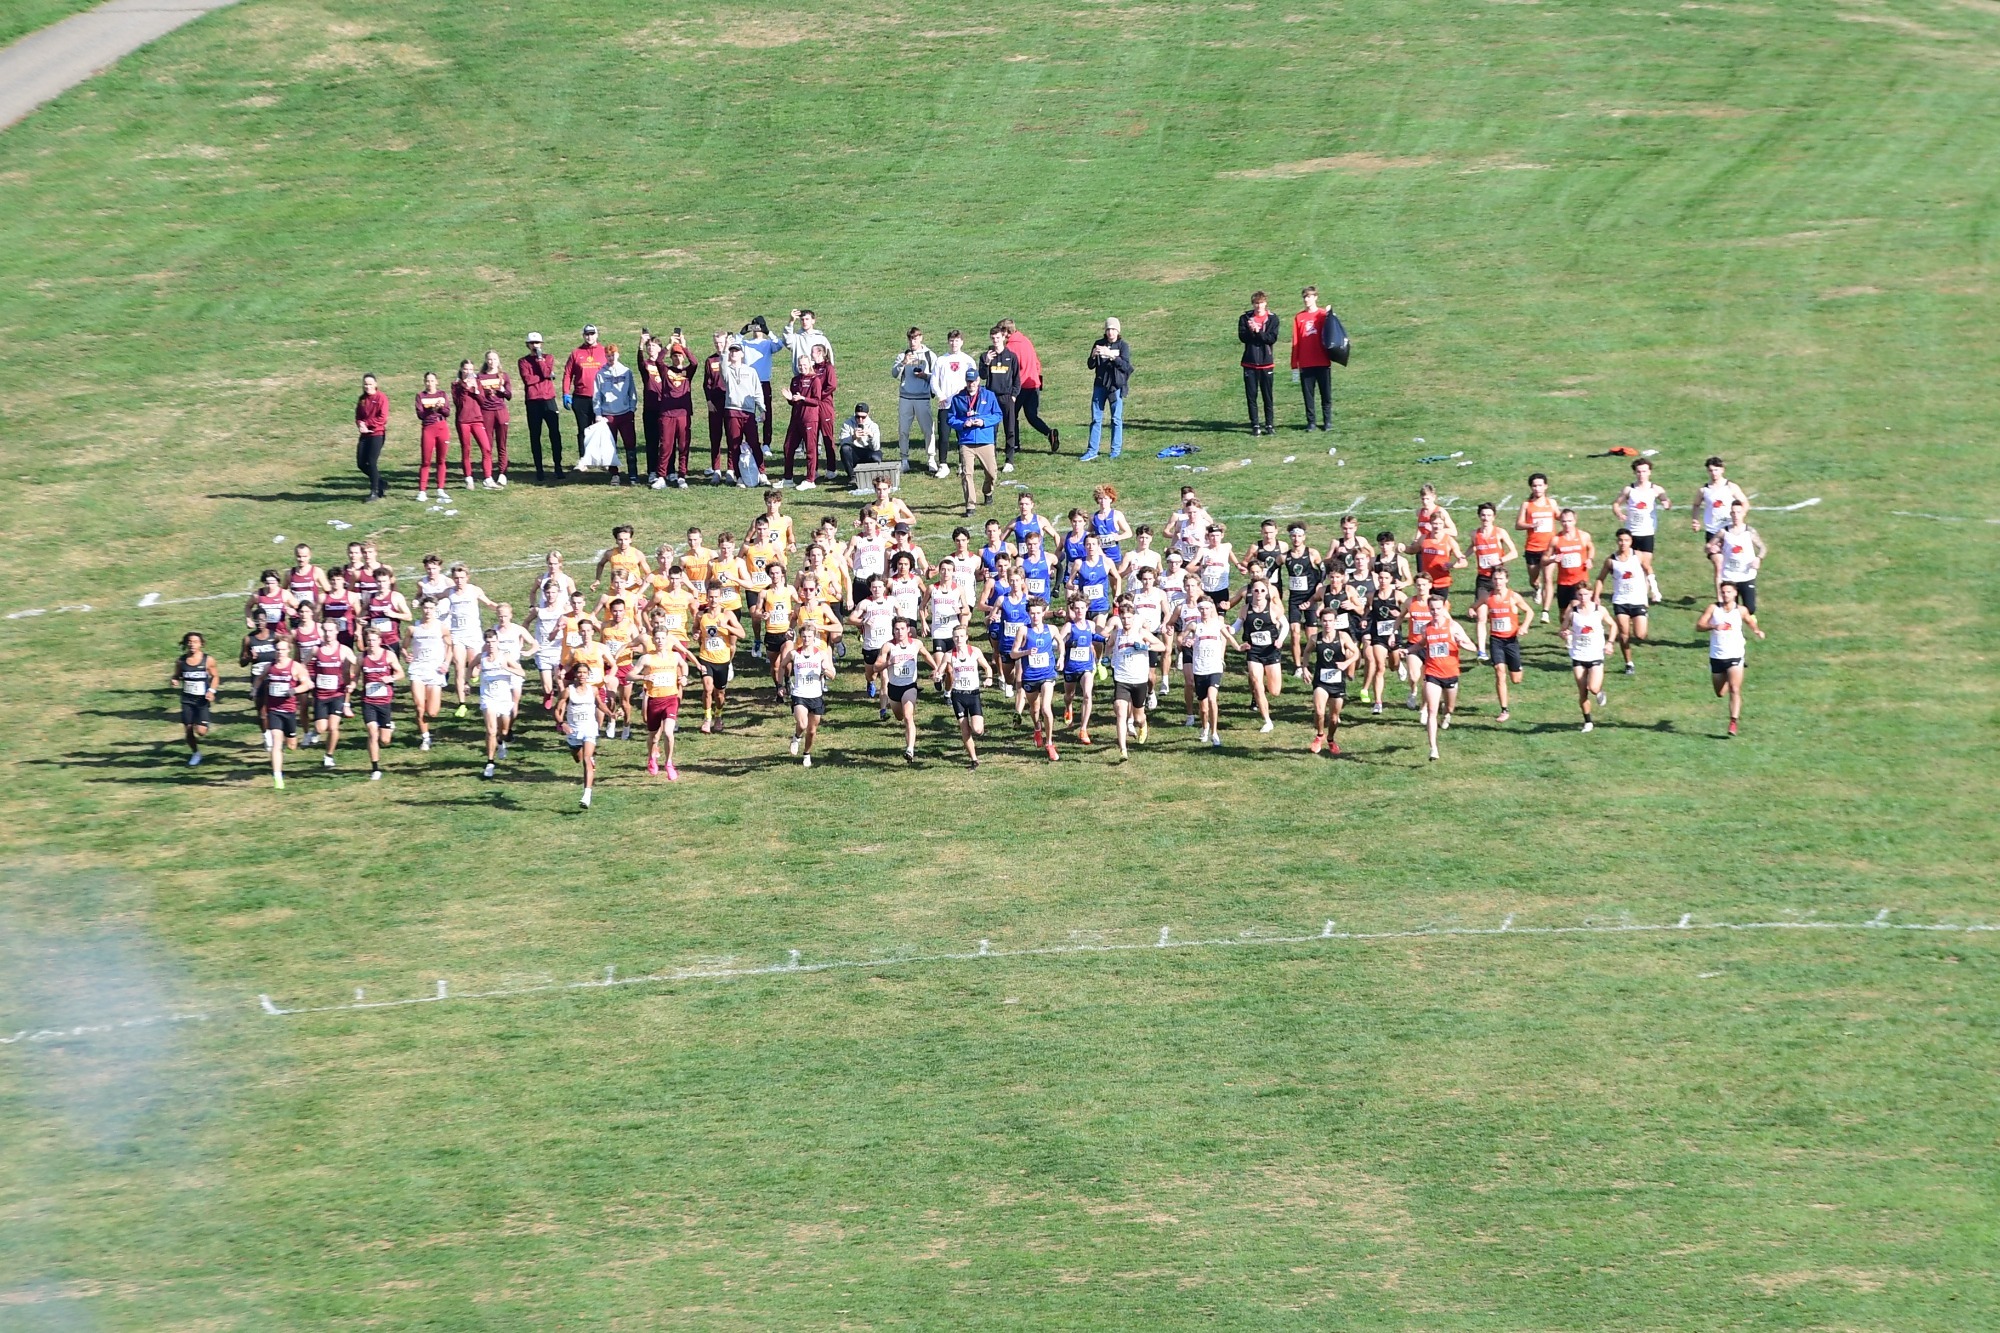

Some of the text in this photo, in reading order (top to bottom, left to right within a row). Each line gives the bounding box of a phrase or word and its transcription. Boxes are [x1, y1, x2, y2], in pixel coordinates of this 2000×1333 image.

[1029, 582, 1040, 590] 147
[708, 640, 720, 649] 164
[898, 667, 910, 676] 140
[960, 679, 971, 687] 134
